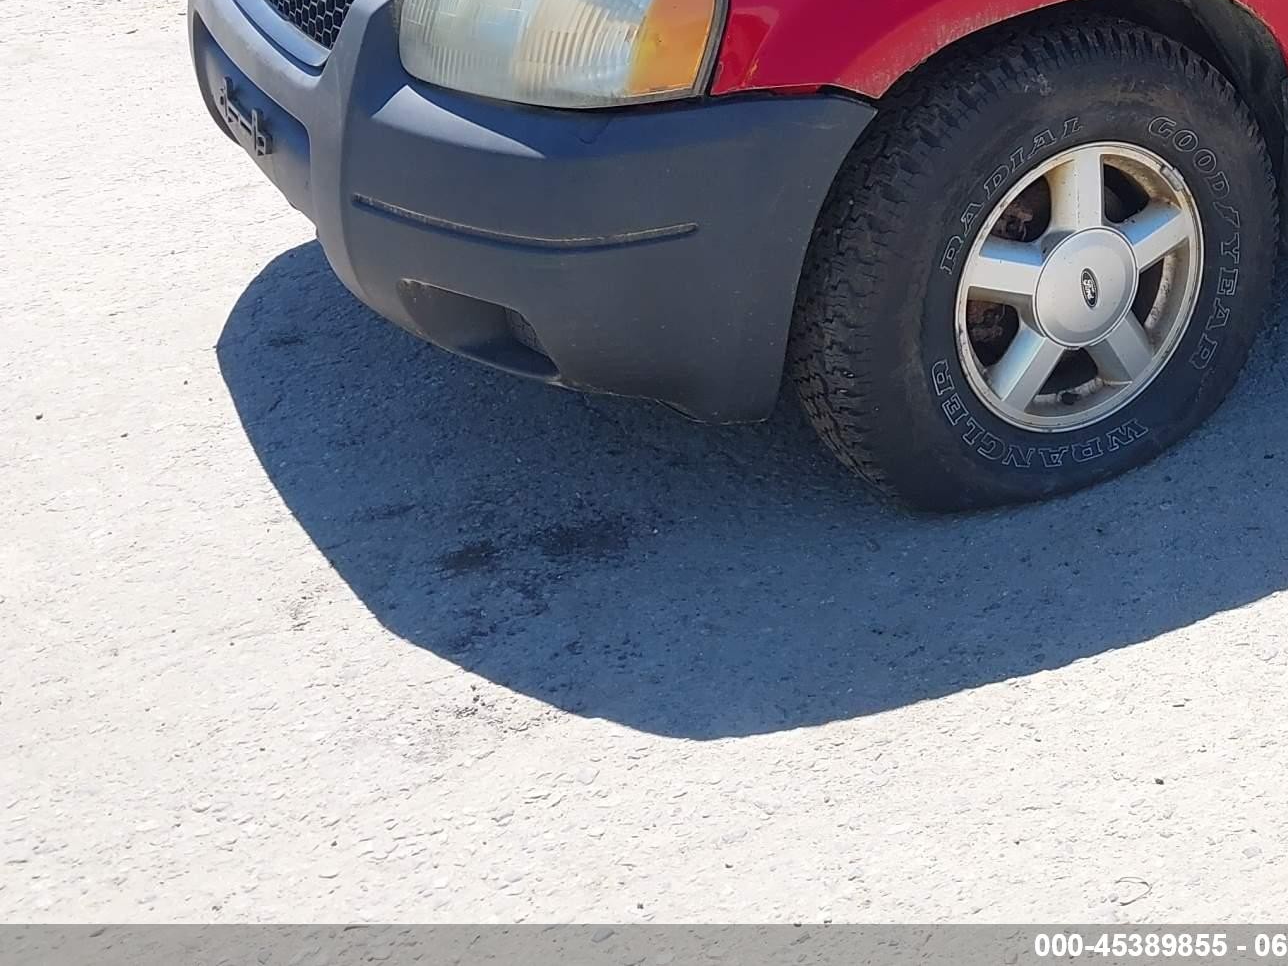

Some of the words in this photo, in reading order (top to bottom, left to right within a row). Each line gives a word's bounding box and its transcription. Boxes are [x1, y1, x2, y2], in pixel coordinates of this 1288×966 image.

[940, 117, 1084, 274] RADIAL
[1148, 115, 1241, 370] GOODYEAR
[931, 359, 1149, 468] WRANGLER
